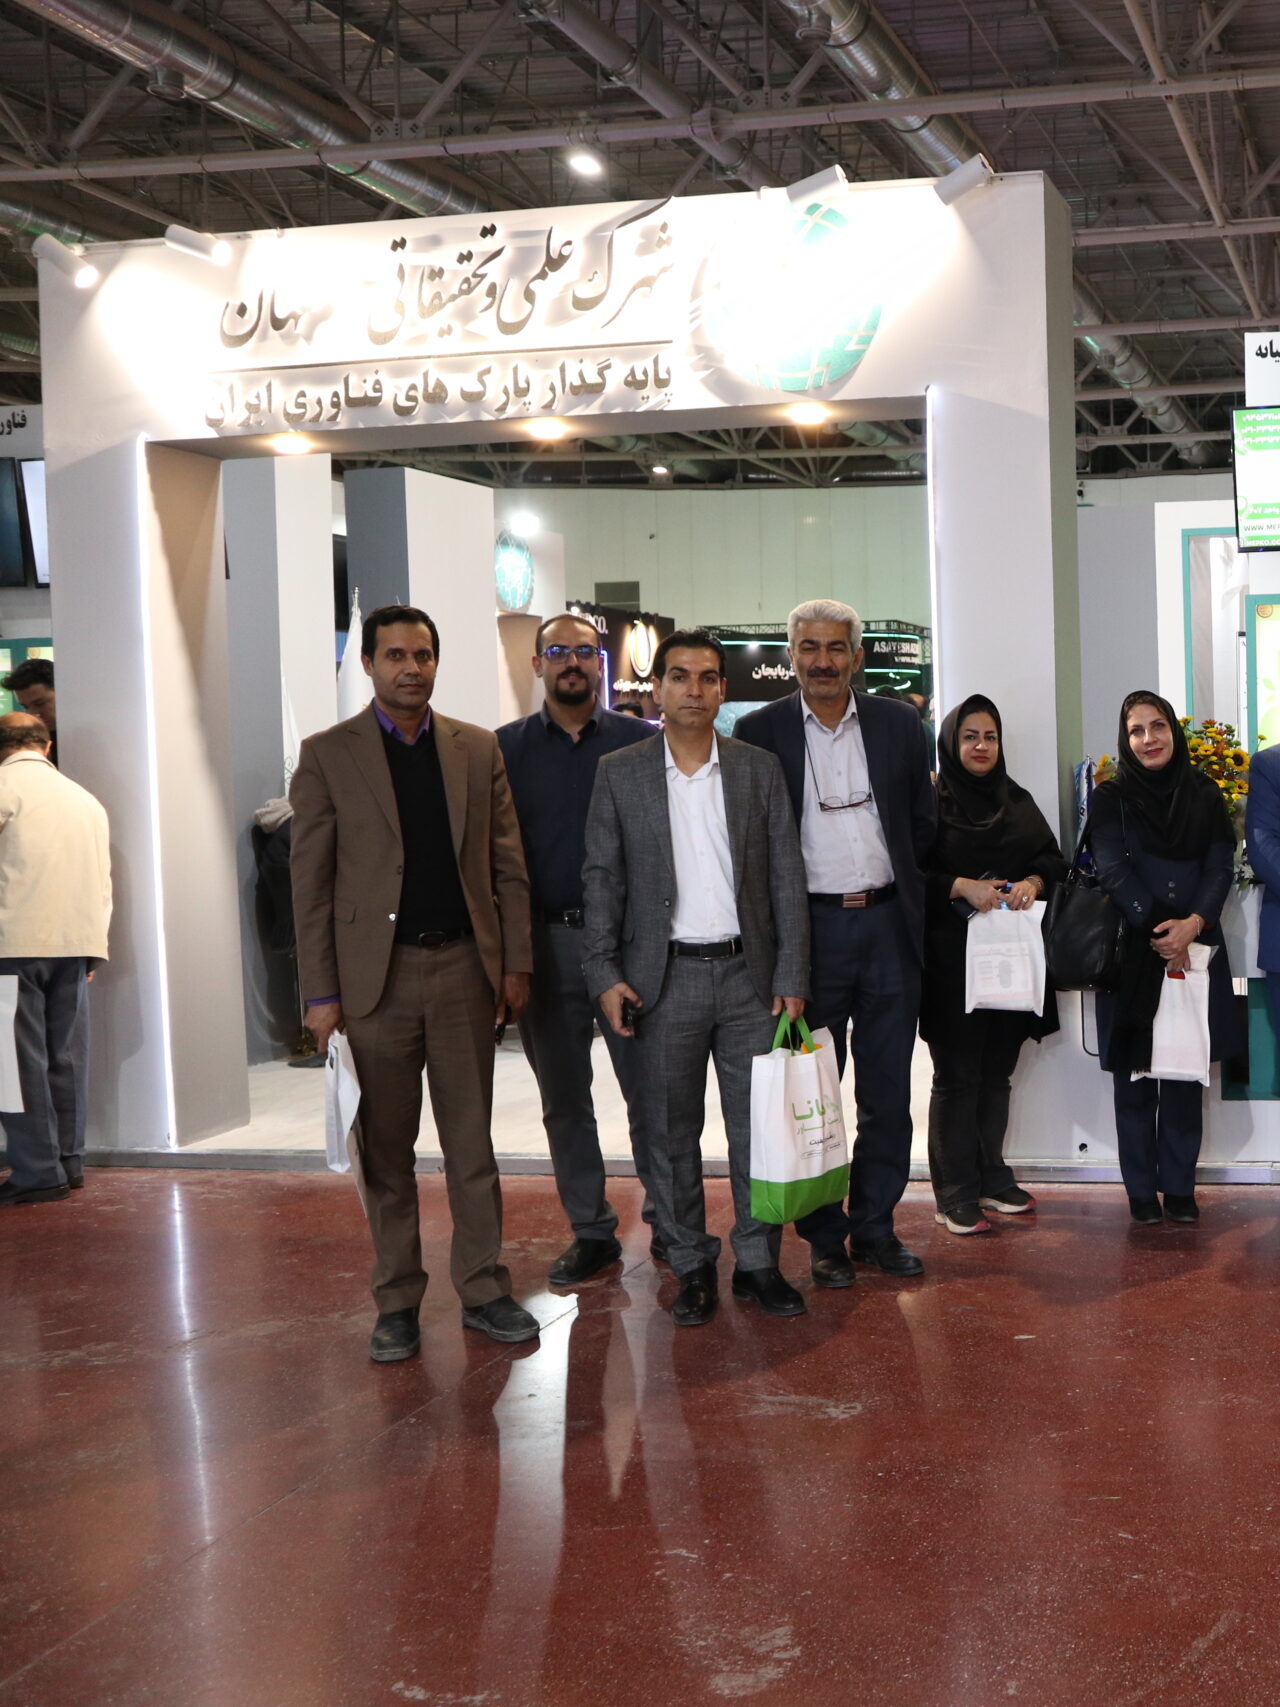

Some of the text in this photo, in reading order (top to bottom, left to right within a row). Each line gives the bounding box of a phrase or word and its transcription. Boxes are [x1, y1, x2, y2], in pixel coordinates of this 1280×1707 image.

[495, 225, 574, 337] علمی
[571, 194, 675, 329] شهرک
[204, 353, 674, 427] پایه گذار پارک های فناوری ایران
[752, 663, 797, 680] ذربایجان
